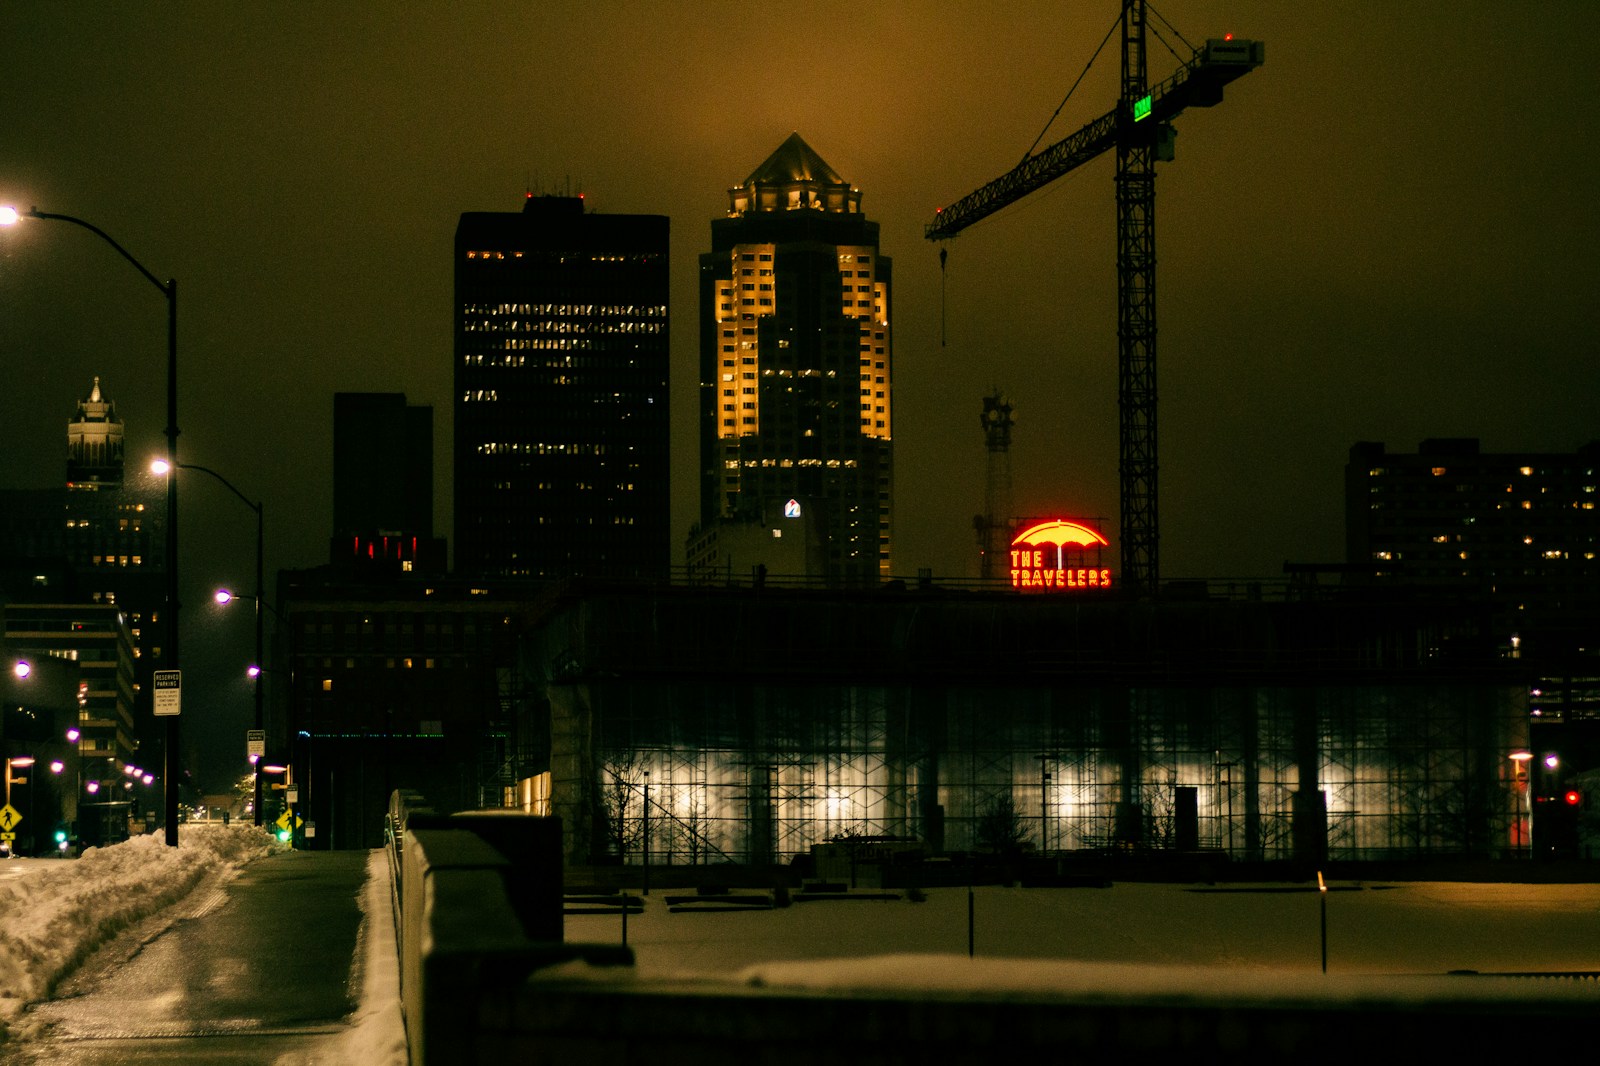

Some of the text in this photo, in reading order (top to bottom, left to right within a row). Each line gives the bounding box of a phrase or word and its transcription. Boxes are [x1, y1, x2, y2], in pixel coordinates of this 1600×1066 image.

[1010, 550, 1042, 568] THE
[1010, 569, 1111, 587] TRAVELERS
[156, 680, 177, 688] PARKING
